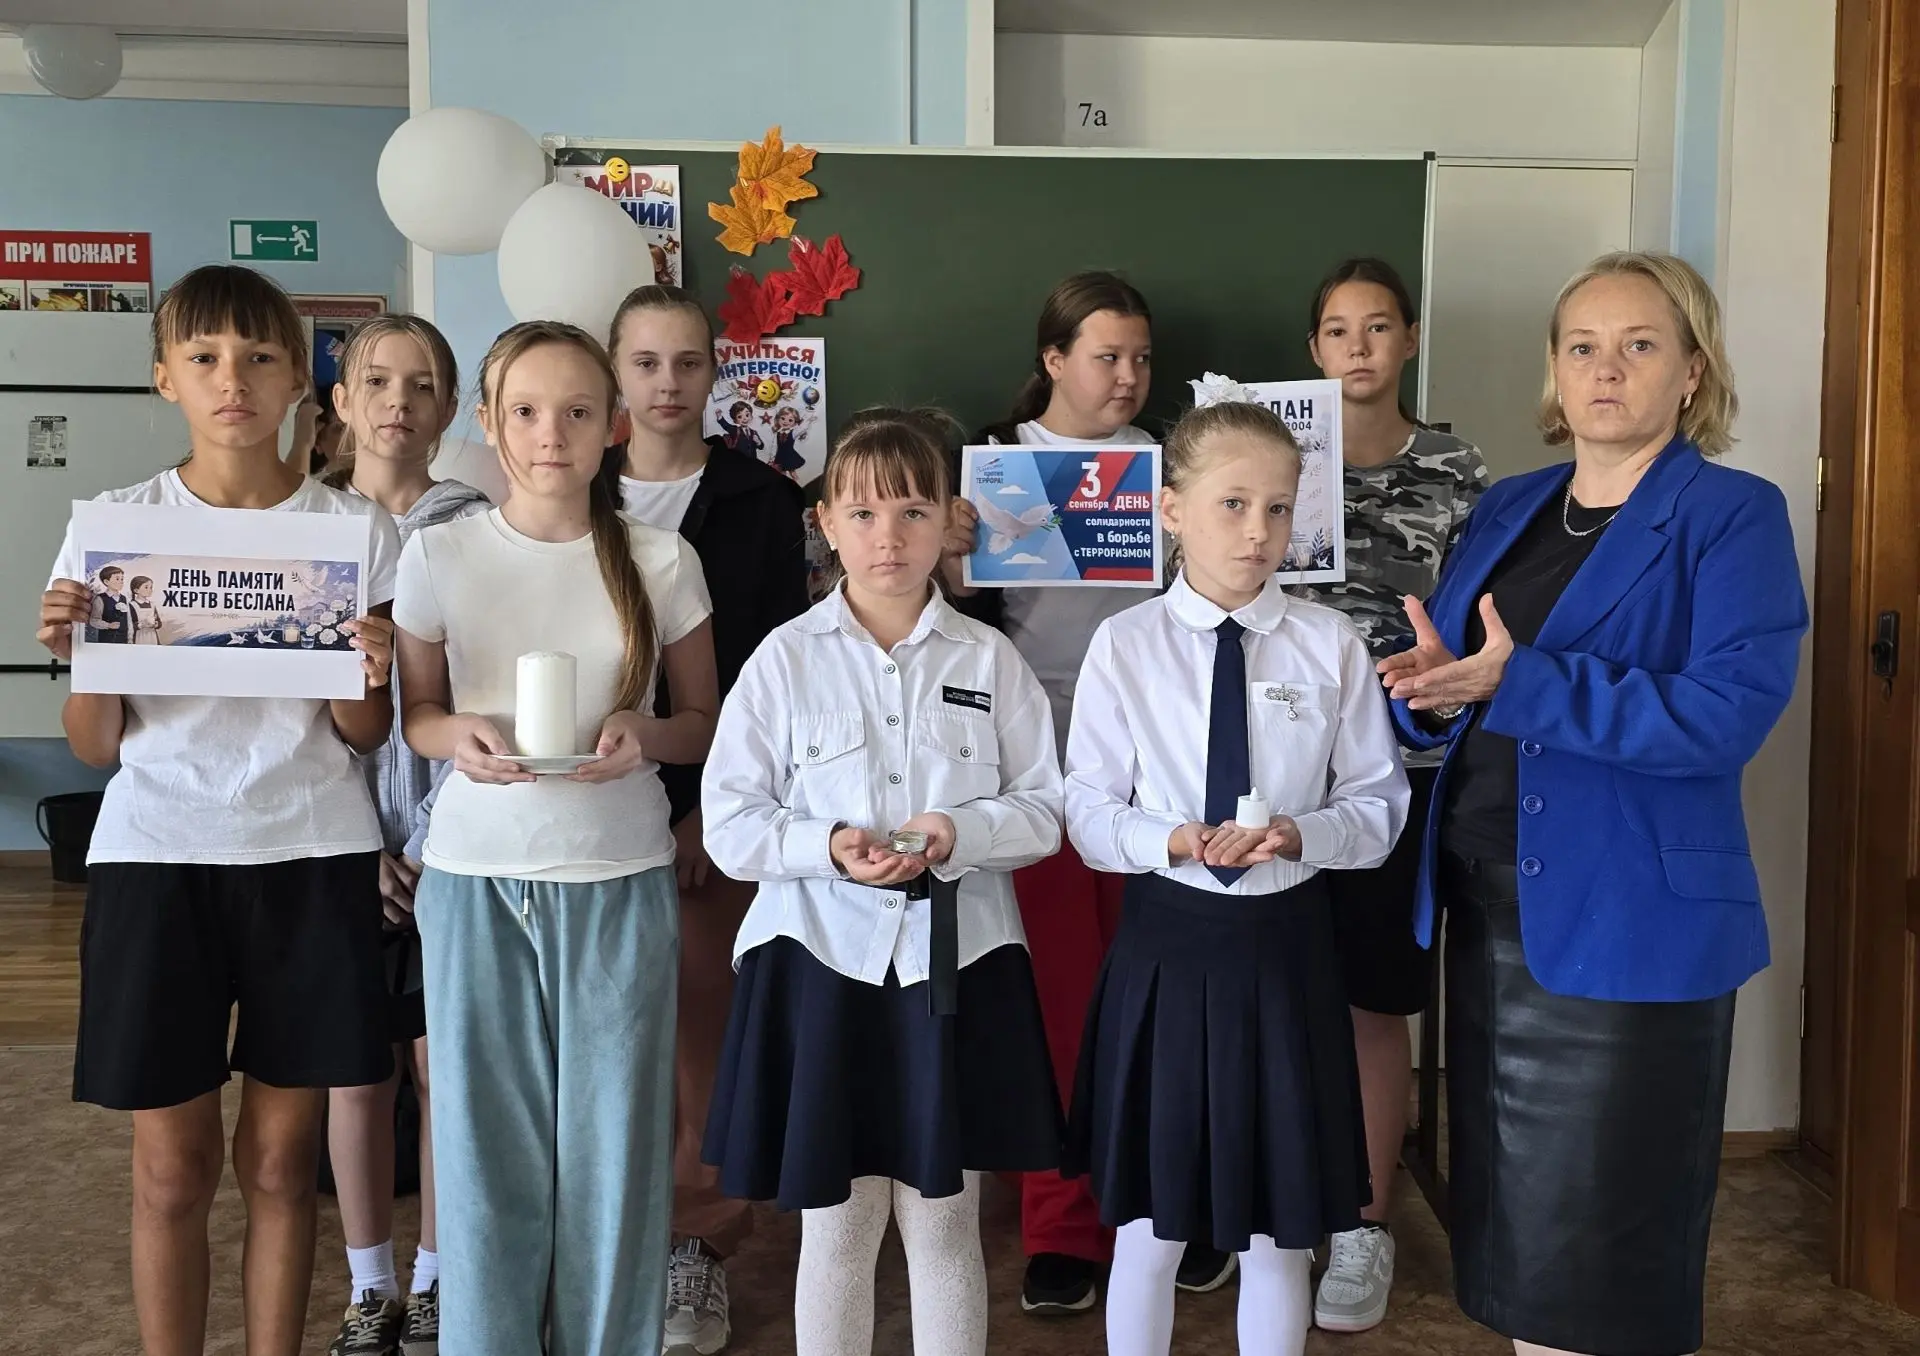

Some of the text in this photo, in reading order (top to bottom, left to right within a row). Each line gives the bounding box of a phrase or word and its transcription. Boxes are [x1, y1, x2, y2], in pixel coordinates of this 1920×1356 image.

[1078, 102, 1108, 127] 7а
[584, 172, 654, 198] МИР
[620, 201, 675, 229] НИЙ
[4, 242, 138, 264] ПРИ ПОЖАРЕ
[716, 343, 815, 365] УЧИТЬСЯ
[1257, 399, 1313, 419] ЛАН
[1080, 461, 1101, 498] 3
[1068, 495, 1151, 511] сентября ДЕНЬ
[1085, 518, 1151, 528] солидарности
[1096, 530, 1151, 546] в борьбе
[1074, 547, 1151, 558] с ТЕРРОРИЗМОМ
[168, 568, 284, 590] ДЕНЬ ПАМЯТИ
[162, 590, 296, 611] ЖЕРТВ БЕСЛАНА
